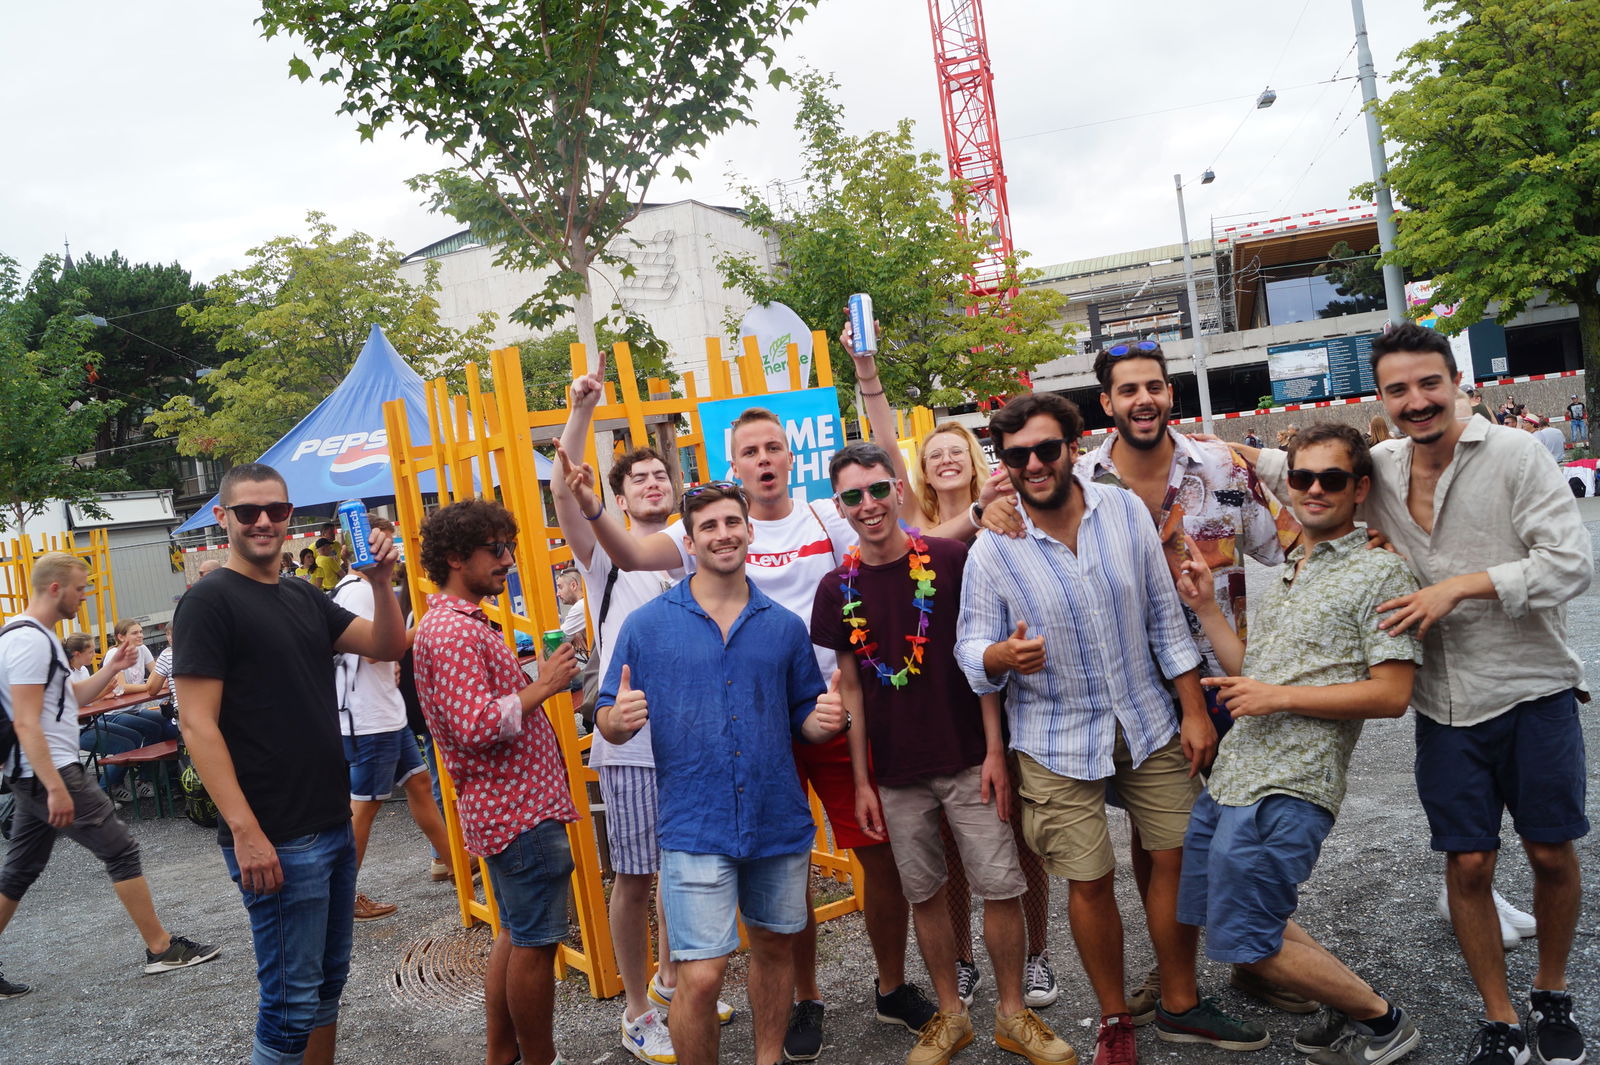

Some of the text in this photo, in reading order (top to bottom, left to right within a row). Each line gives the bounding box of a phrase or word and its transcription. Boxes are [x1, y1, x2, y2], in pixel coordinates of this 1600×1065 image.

[290, 428, 389, 462] PEPS
[982, 444, 994, 453] CH
[985, 452, 1000, 463] AL
[349, 510, 369, 562] Quöllfrisch
